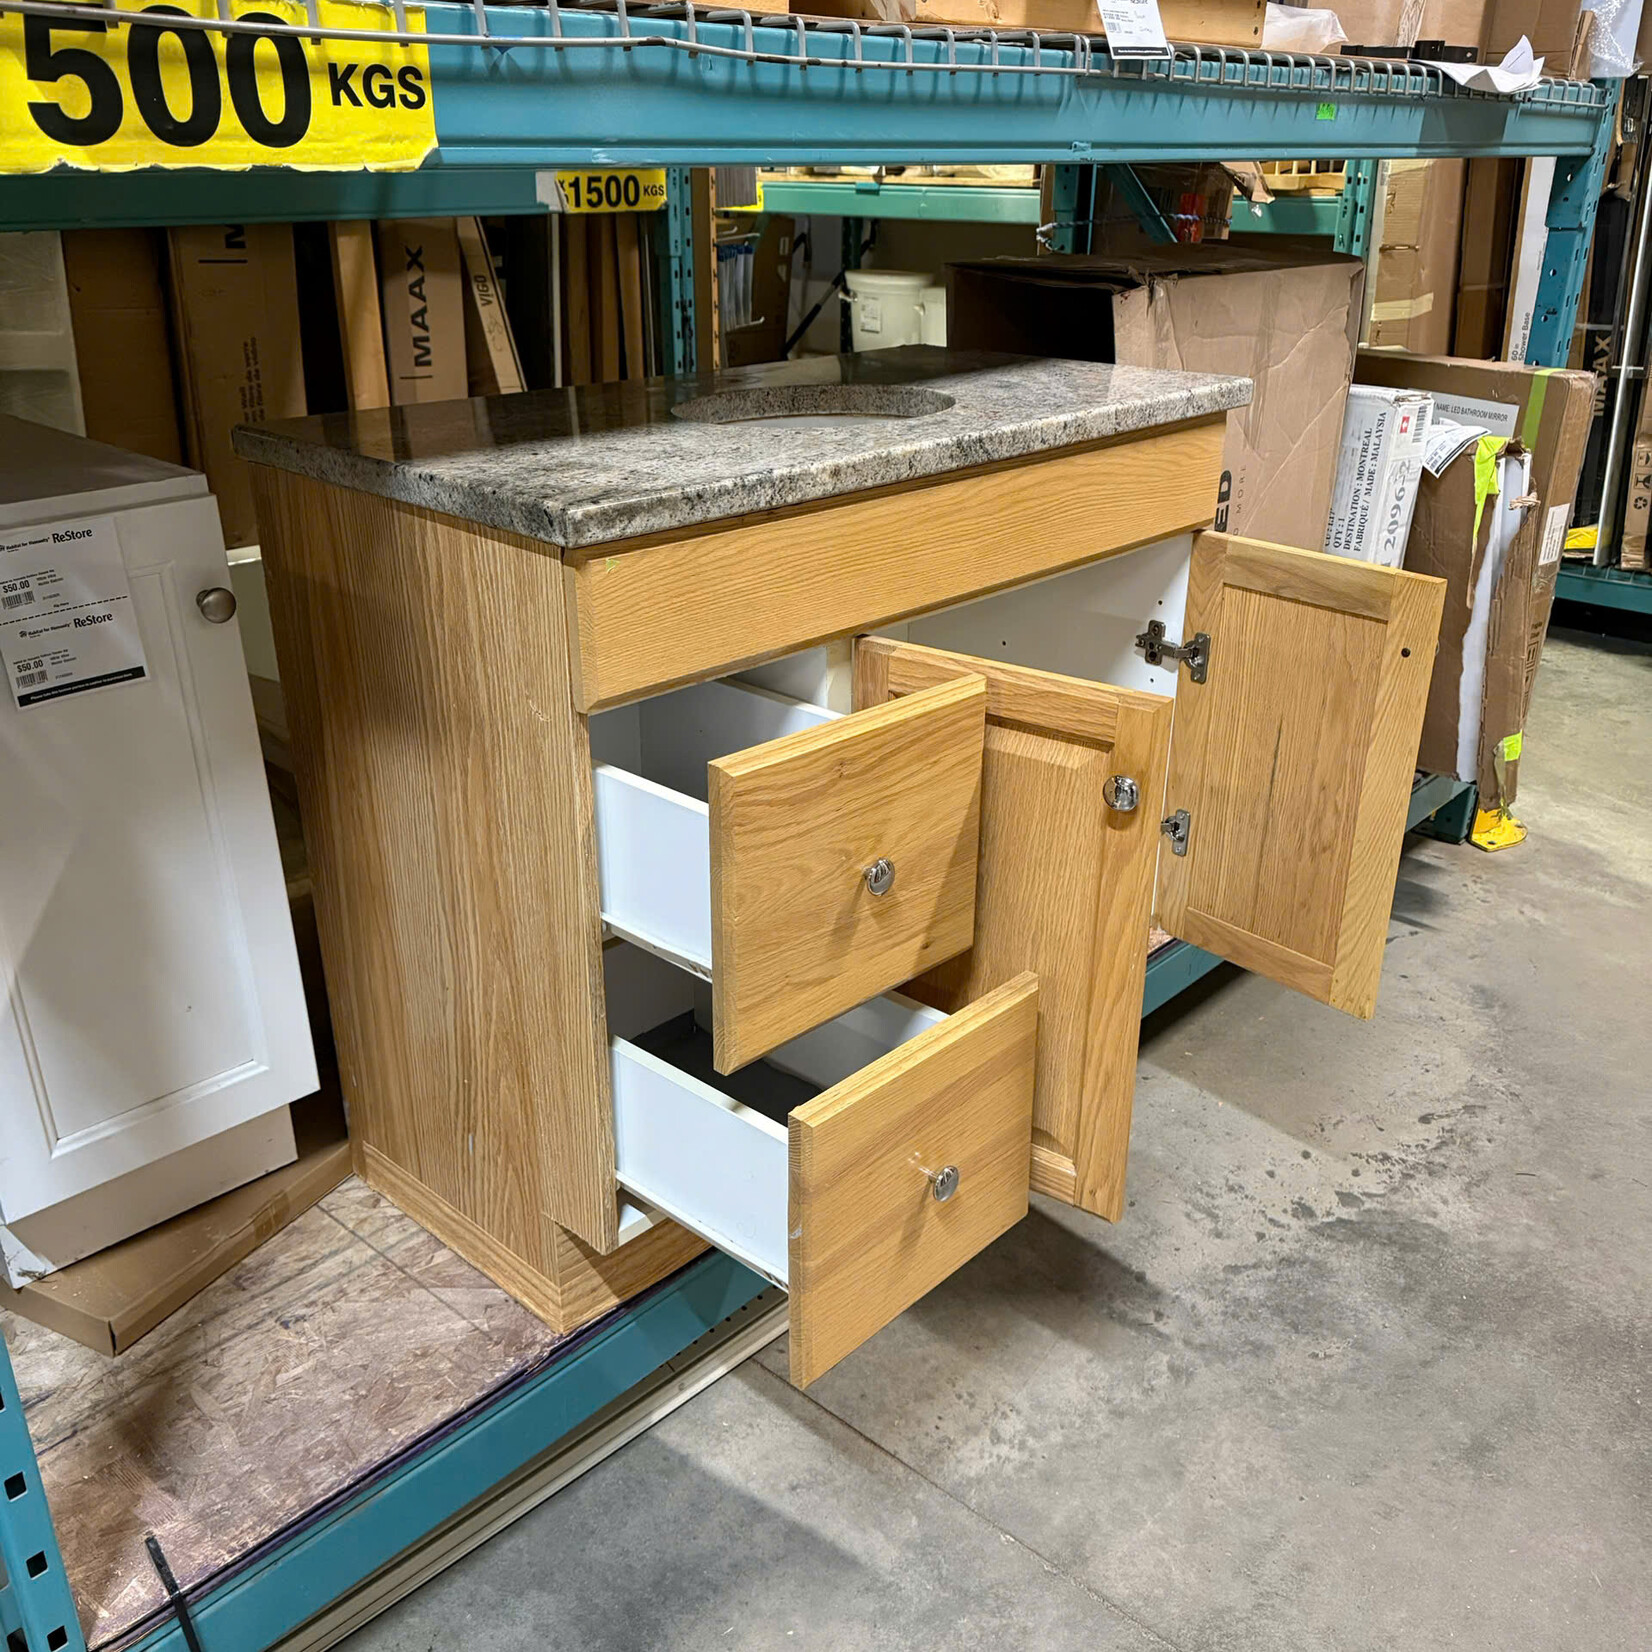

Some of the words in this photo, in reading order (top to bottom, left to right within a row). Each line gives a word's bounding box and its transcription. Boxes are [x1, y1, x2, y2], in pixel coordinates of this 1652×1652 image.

[23, 0, 312, 148] 500
[328, 62, 426, 110] KGS
[569, 174, 640, 208] 1500
[643, 184, 664, 197] KGS
[474, 275, 494, 307] VIGO
[405, 245, 432, 367] MAAX
[1522, 312, 1531, 331] Base
[1518, 331, 1528, 361] Shower
[1451, 405, 1460, 415] LED
[1461, 406, 1488, 419] BATHROOM
[1488, 412, 1508, 422] MIRROR
[1343, 488, 1361, 551] DESTINATION
[1356, 428, 1373, 481] MONTREAL
[1354, 504, 1370, 552] FABRIQUÉ
[1364, 470, 1376, 497] MADE
[1371, 412, 1387, 462] MALAYSIA
[52, 529, 93, 544] ReStore
[1333, 528, 1342, 549] QTY
[3, 580, 30, 593] $50.00
[73, 613, 113, 628] ReStore
[17, 660, 43, 673] $50.00
